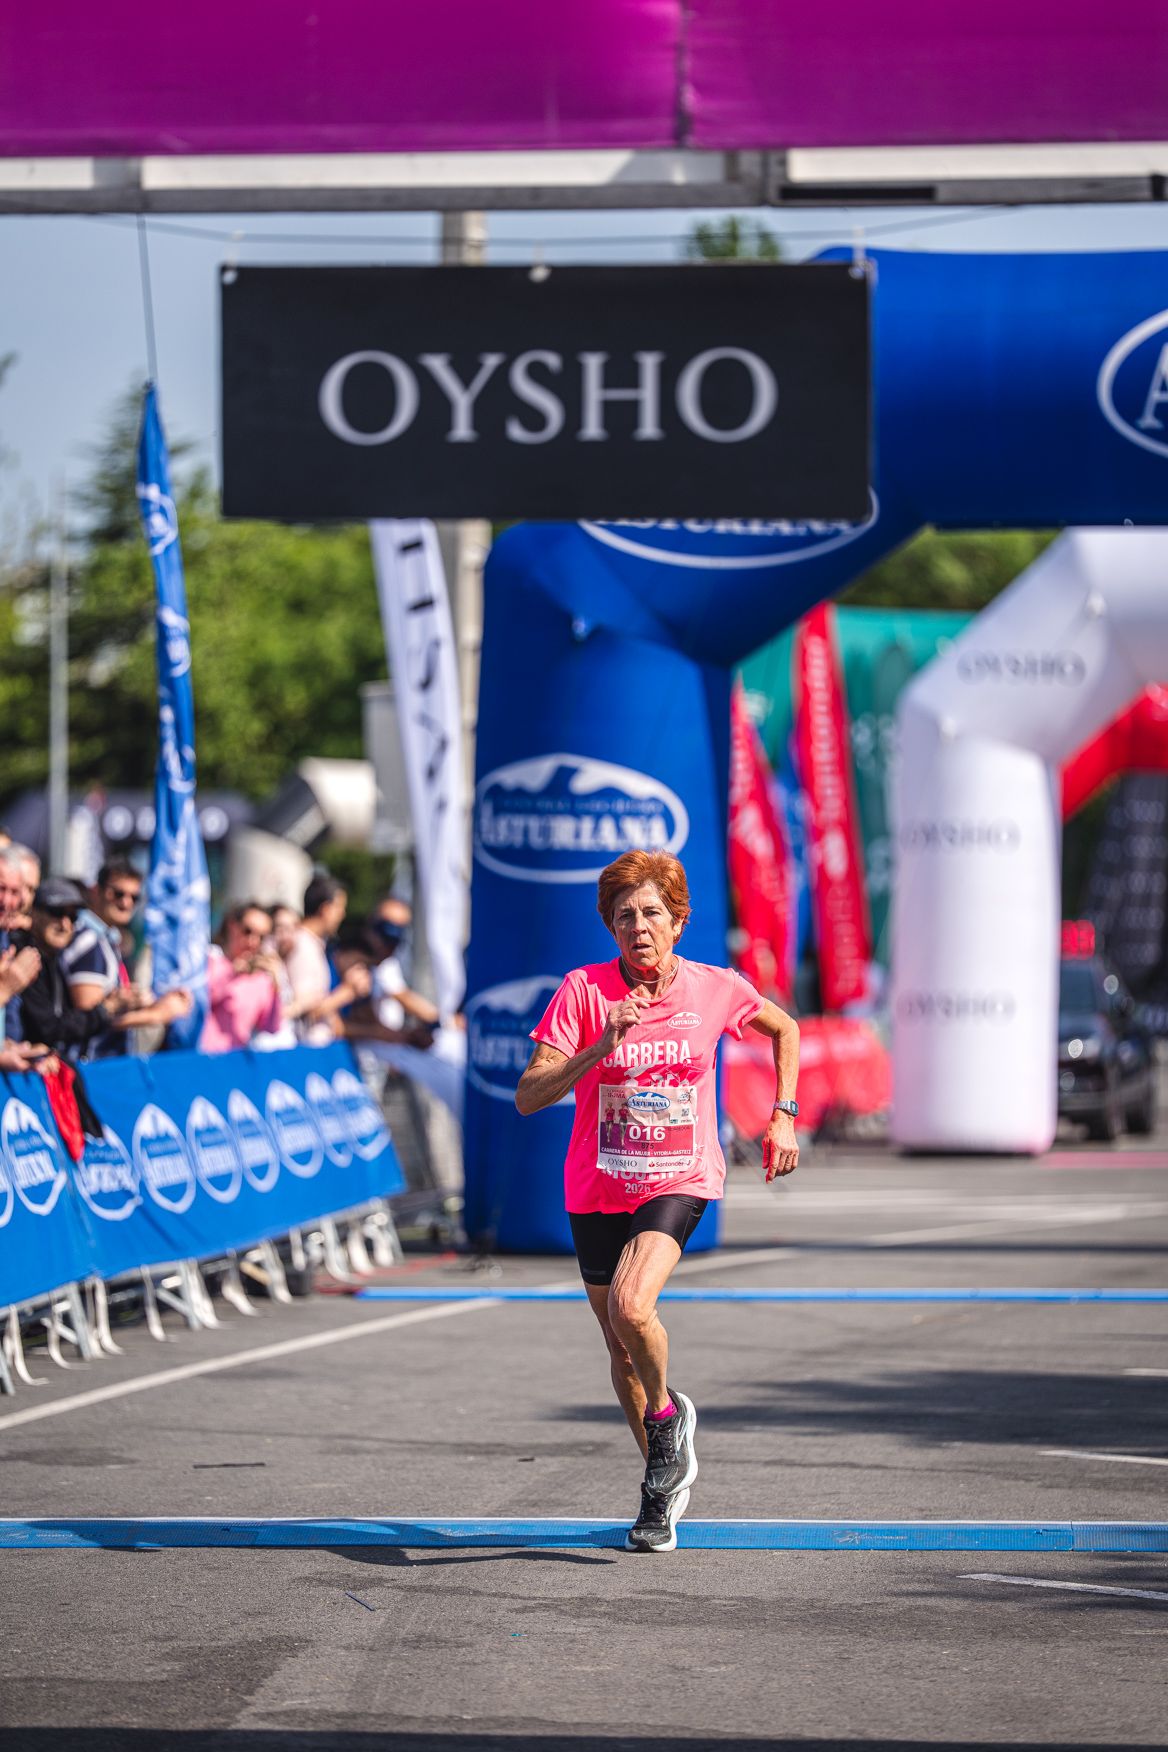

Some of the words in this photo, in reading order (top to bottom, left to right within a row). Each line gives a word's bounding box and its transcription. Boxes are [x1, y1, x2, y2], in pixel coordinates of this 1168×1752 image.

[318, 346, 778, 446] OYSHO
[631, 1099, 667, 1107] ASTURIANA
[629, 1126, 666, 1140] 016
[608, 1158, 638, 1168] OYSHO
